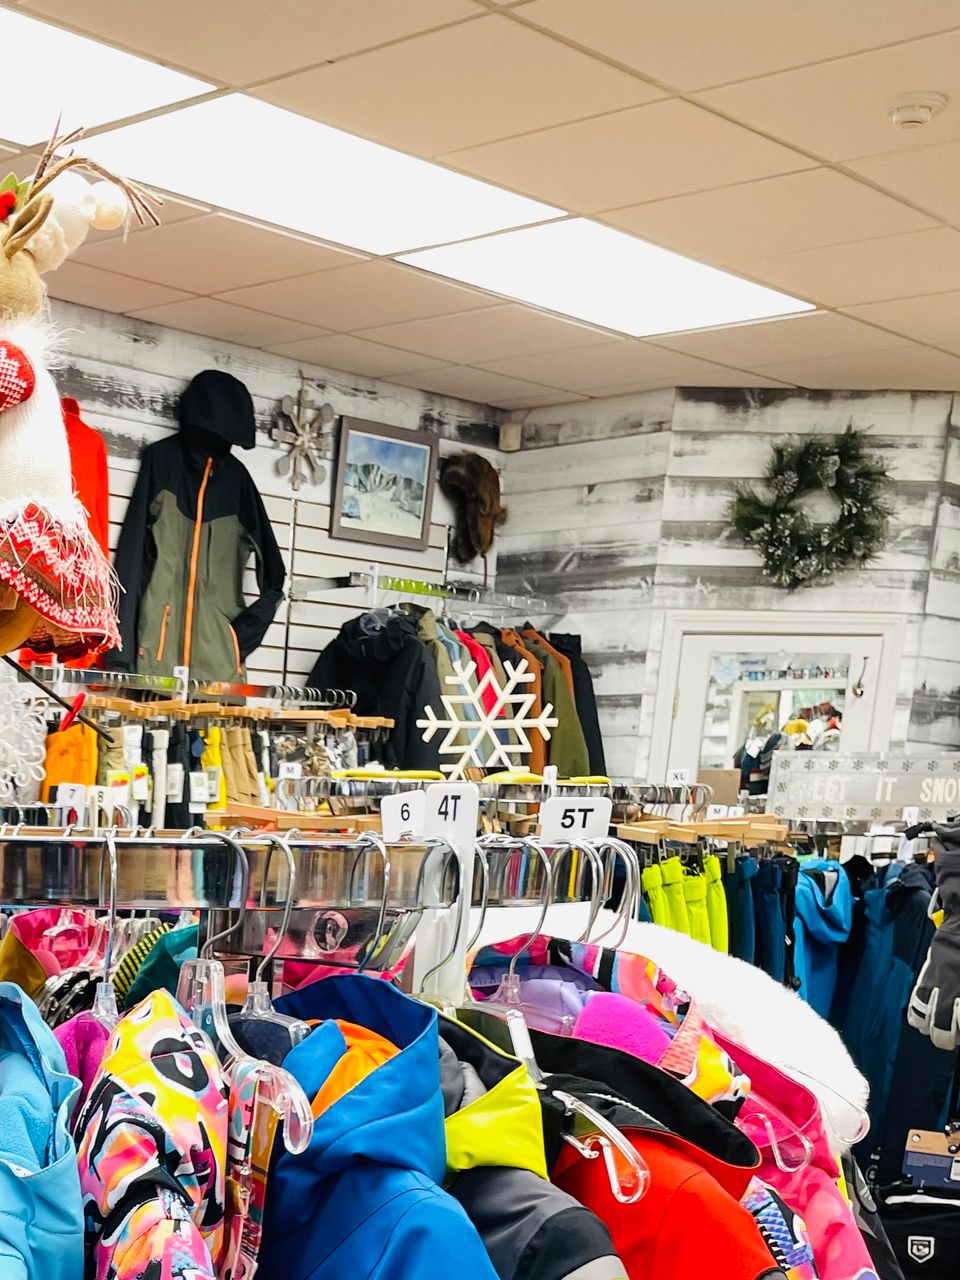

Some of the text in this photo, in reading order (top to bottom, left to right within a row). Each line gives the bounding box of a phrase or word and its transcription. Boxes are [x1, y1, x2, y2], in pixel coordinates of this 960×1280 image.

[673, 772, 686, 782] XL
[69, 788, 77, 799] 7
[876, 777, 898, 802] IT
[400, 802, 411, 822] 6
[437, 794, 462, 822] 4T
[560, 807, 595, 830] 5T
